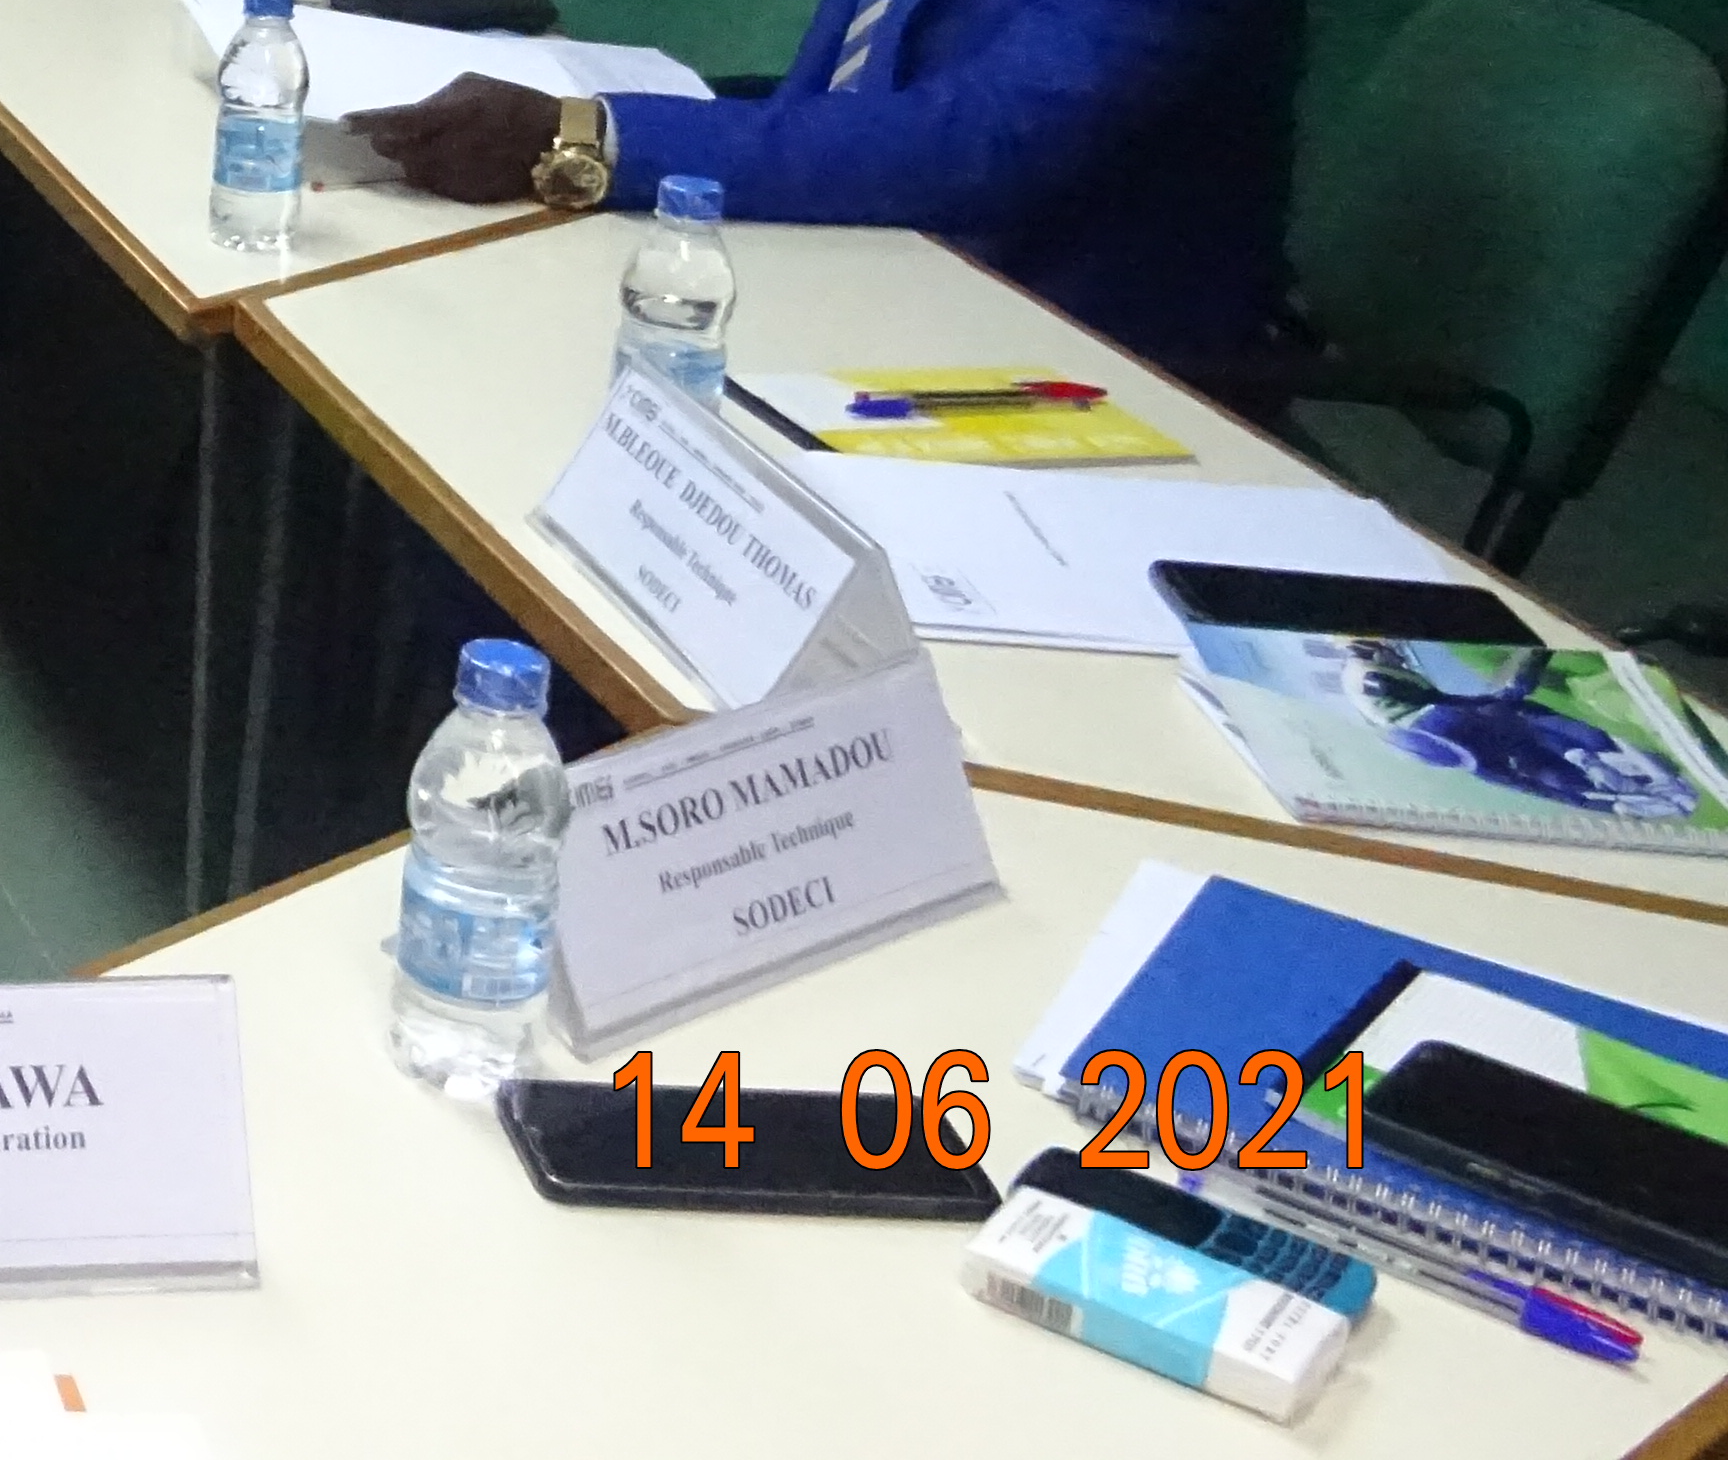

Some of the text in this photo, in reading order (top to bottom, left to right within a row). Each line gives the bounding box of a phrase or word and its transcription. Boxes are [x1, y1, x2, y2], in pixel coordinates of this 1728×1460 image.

[629, 498, 688, 560] Responsable
[679, 479, 745, 545] DJEDOU
[742, 534, 817, 611] THOMAS
[638, 563, 682, 613] SODECI
[602, 786, 727, 856] M.SORO
[734, 729, 893, 809] MAMADOU
[656, 808, 855, 895] Responsable Technique
[732, 878, 837, 938] SODECI
